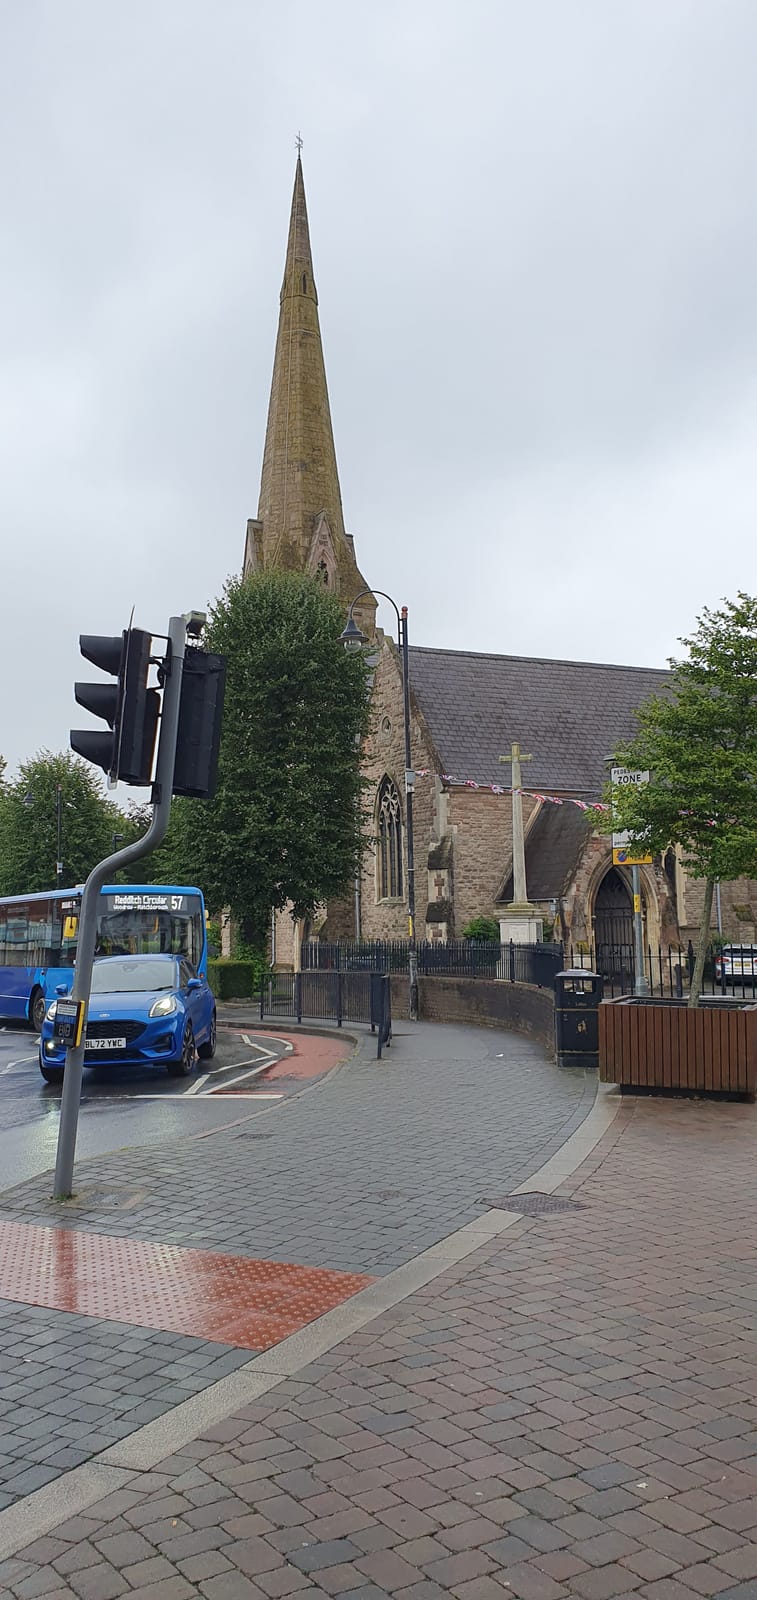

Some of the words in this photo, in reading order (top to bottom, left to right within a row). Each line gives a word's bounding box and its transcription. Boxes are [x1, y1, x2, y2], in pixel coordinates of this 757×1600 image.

[618, 774, 642, 784] ZONE
[115, 896, 142, 904] Redditch
[143, 896, 167, 904] Circular
[172, 896, 183, 910] 57
[86, 1040, 105, 1048] BL72
